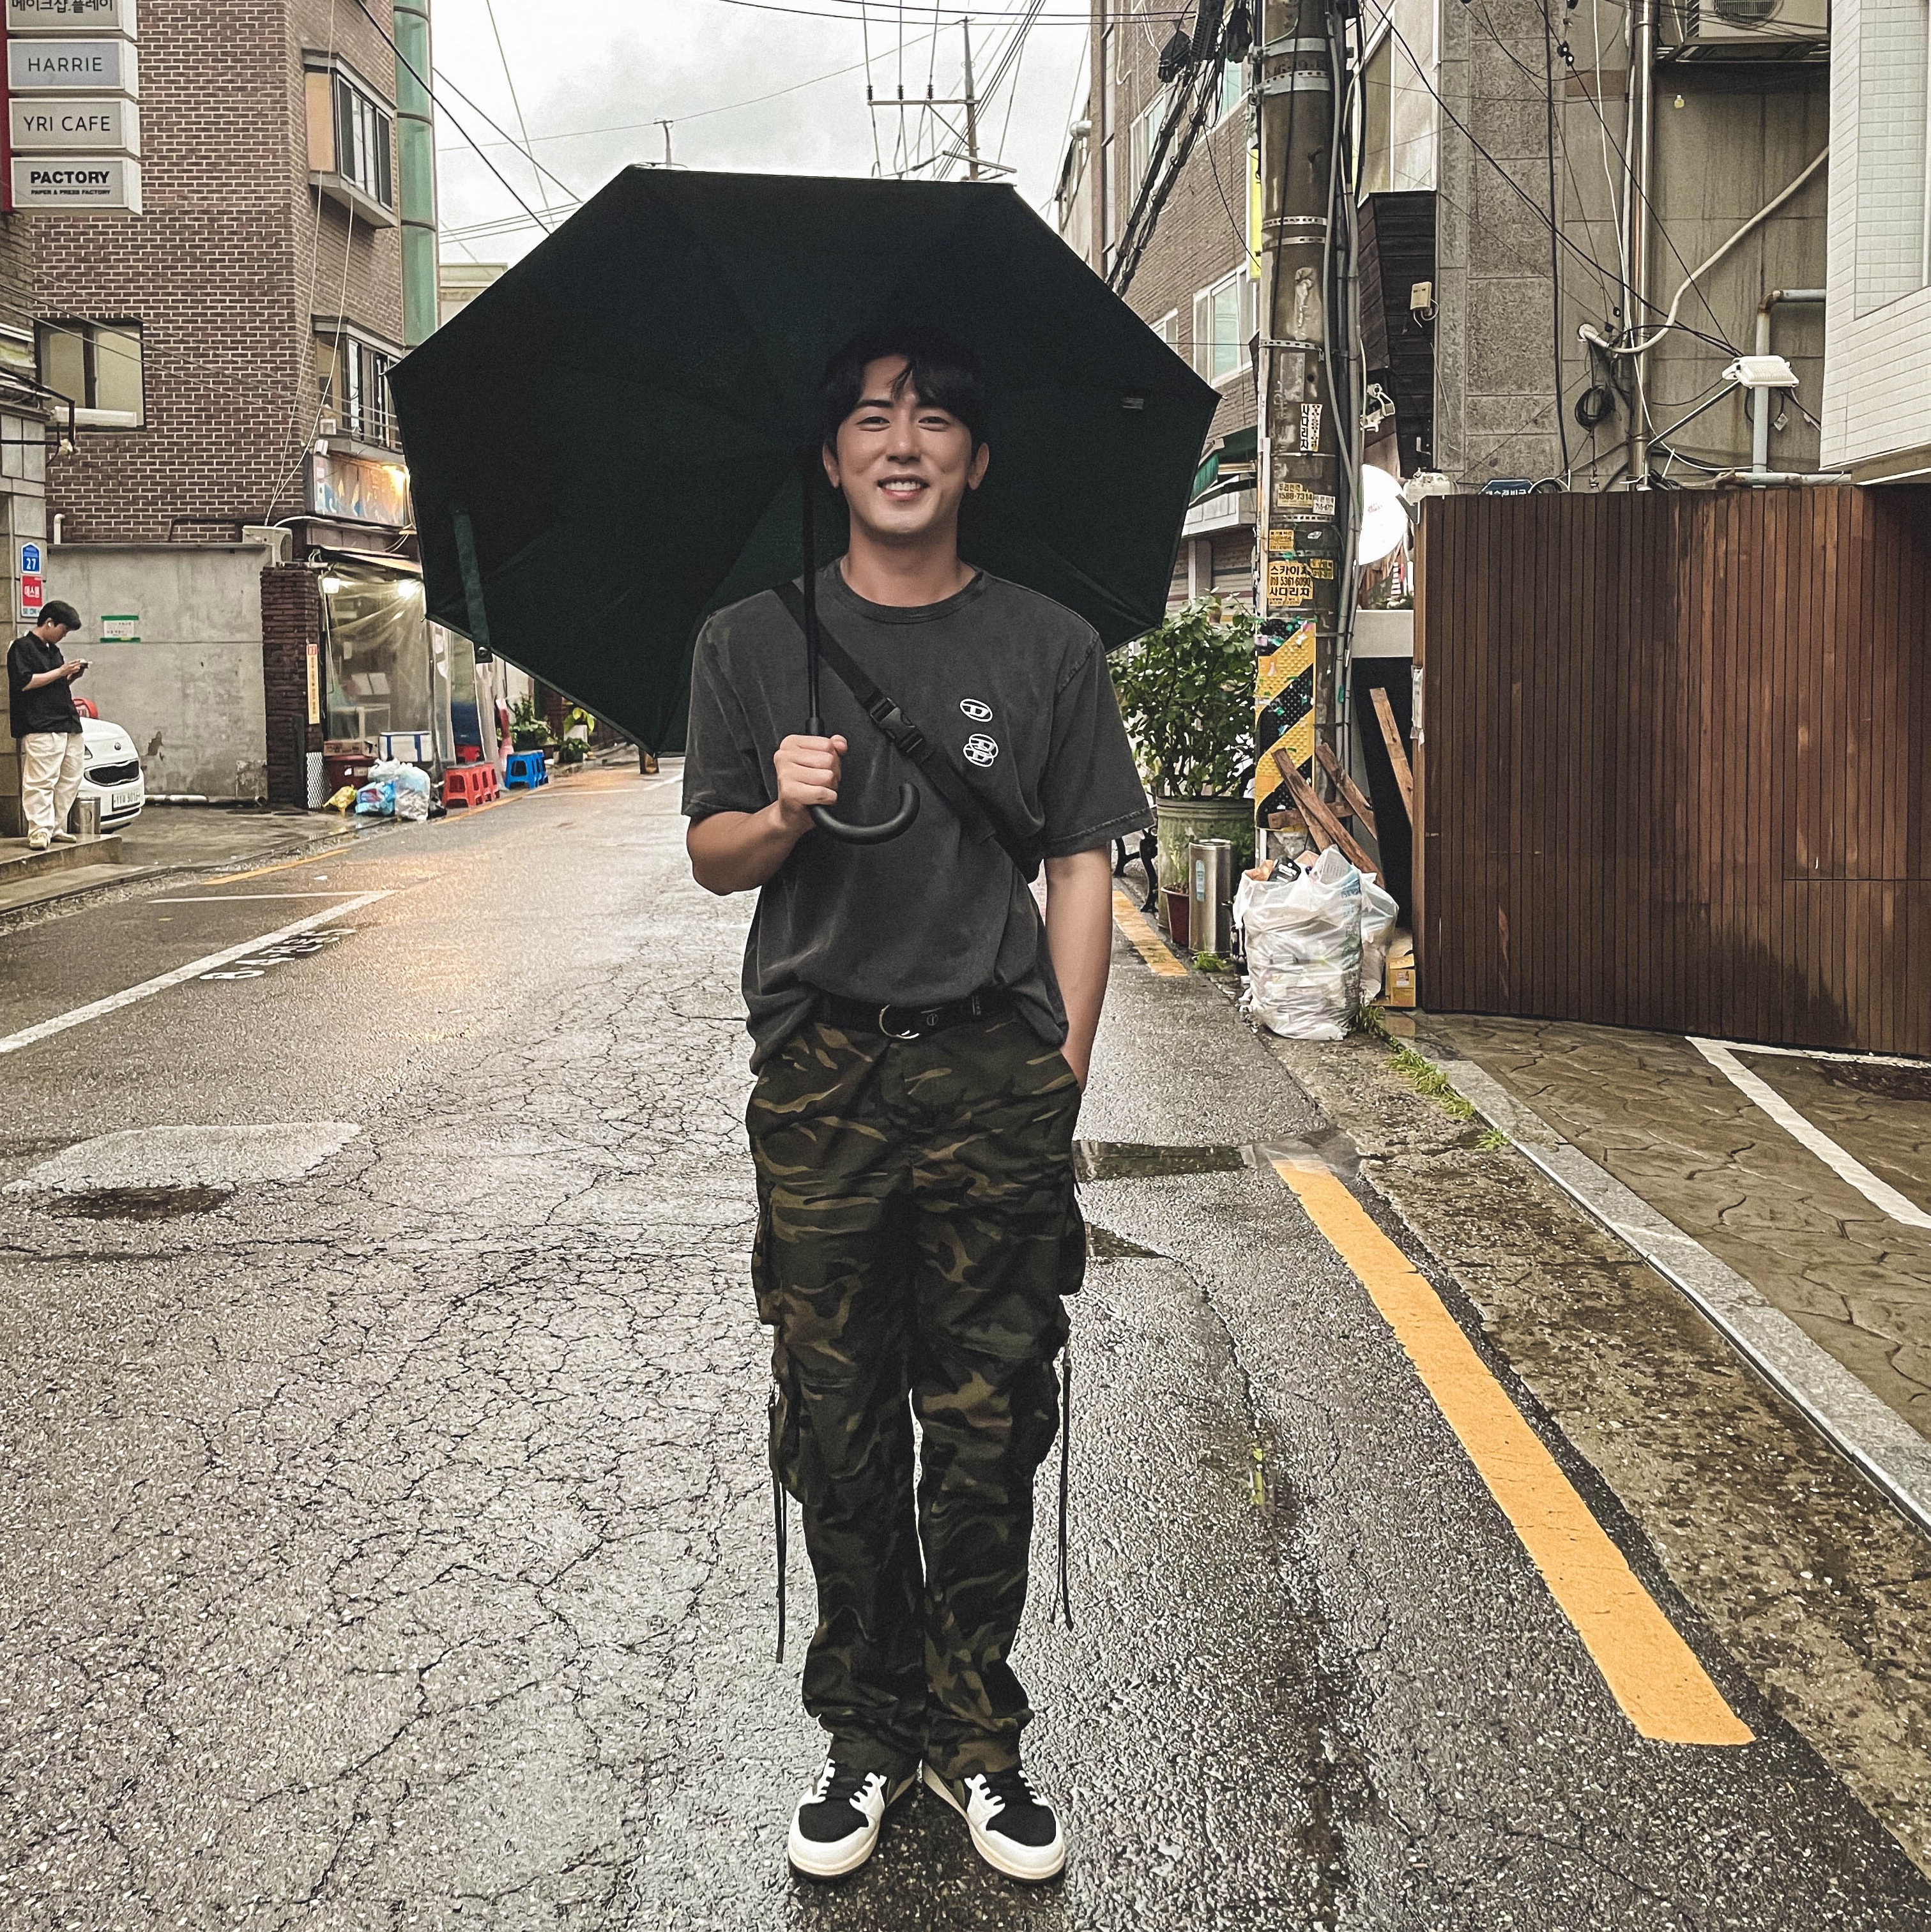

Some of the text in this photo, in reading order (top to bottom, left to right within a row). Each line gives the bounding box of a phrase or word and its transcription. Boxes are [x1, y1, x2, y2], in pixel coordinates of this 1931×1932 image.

[28, 57, 103, 72] HARRIE
[24, 116, 111, 131] YRI CAFE
[31, 171, 110, 183] PACTORY
[26, 558, 36, 570] 27
